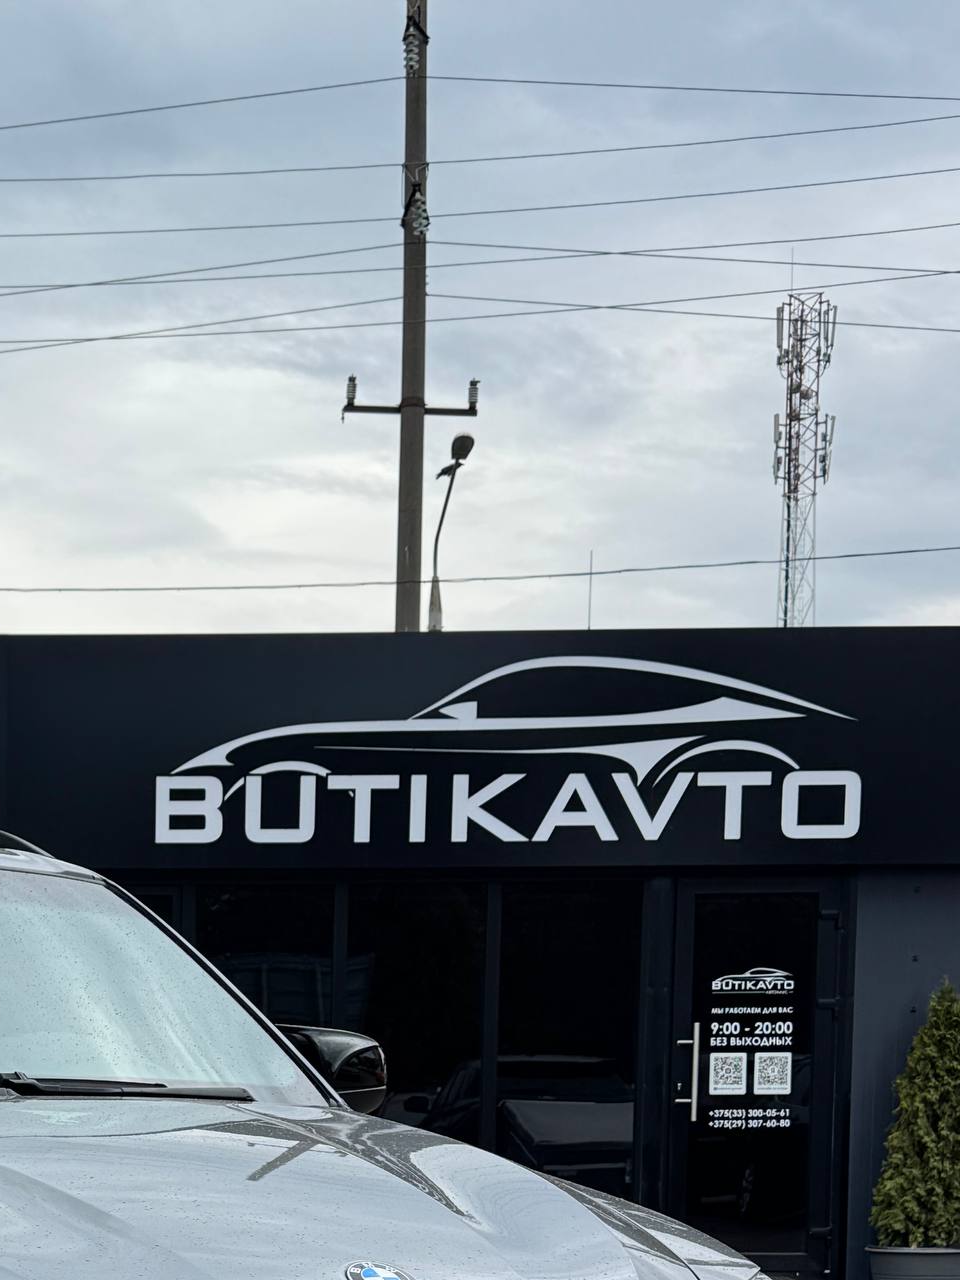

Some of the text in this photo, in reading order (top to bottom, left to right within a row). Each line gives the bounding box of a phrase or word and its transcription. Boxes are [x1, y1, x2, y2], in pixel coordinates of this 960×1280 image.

[154, 769, 862, 844] BUTIKAVTO
[711, 980, 794, 990] BUTIKAVTO
[711, 1007, 724, 1015] МЫ
[711, 1022, 740, 1035] 9:00
[754, 1021, 793, 1034] 20:00
[710, 1036, 792, 1046] БЕЗ ВЫХОДНЫХ
[708, 1109, 746, 1118] +375(33)
